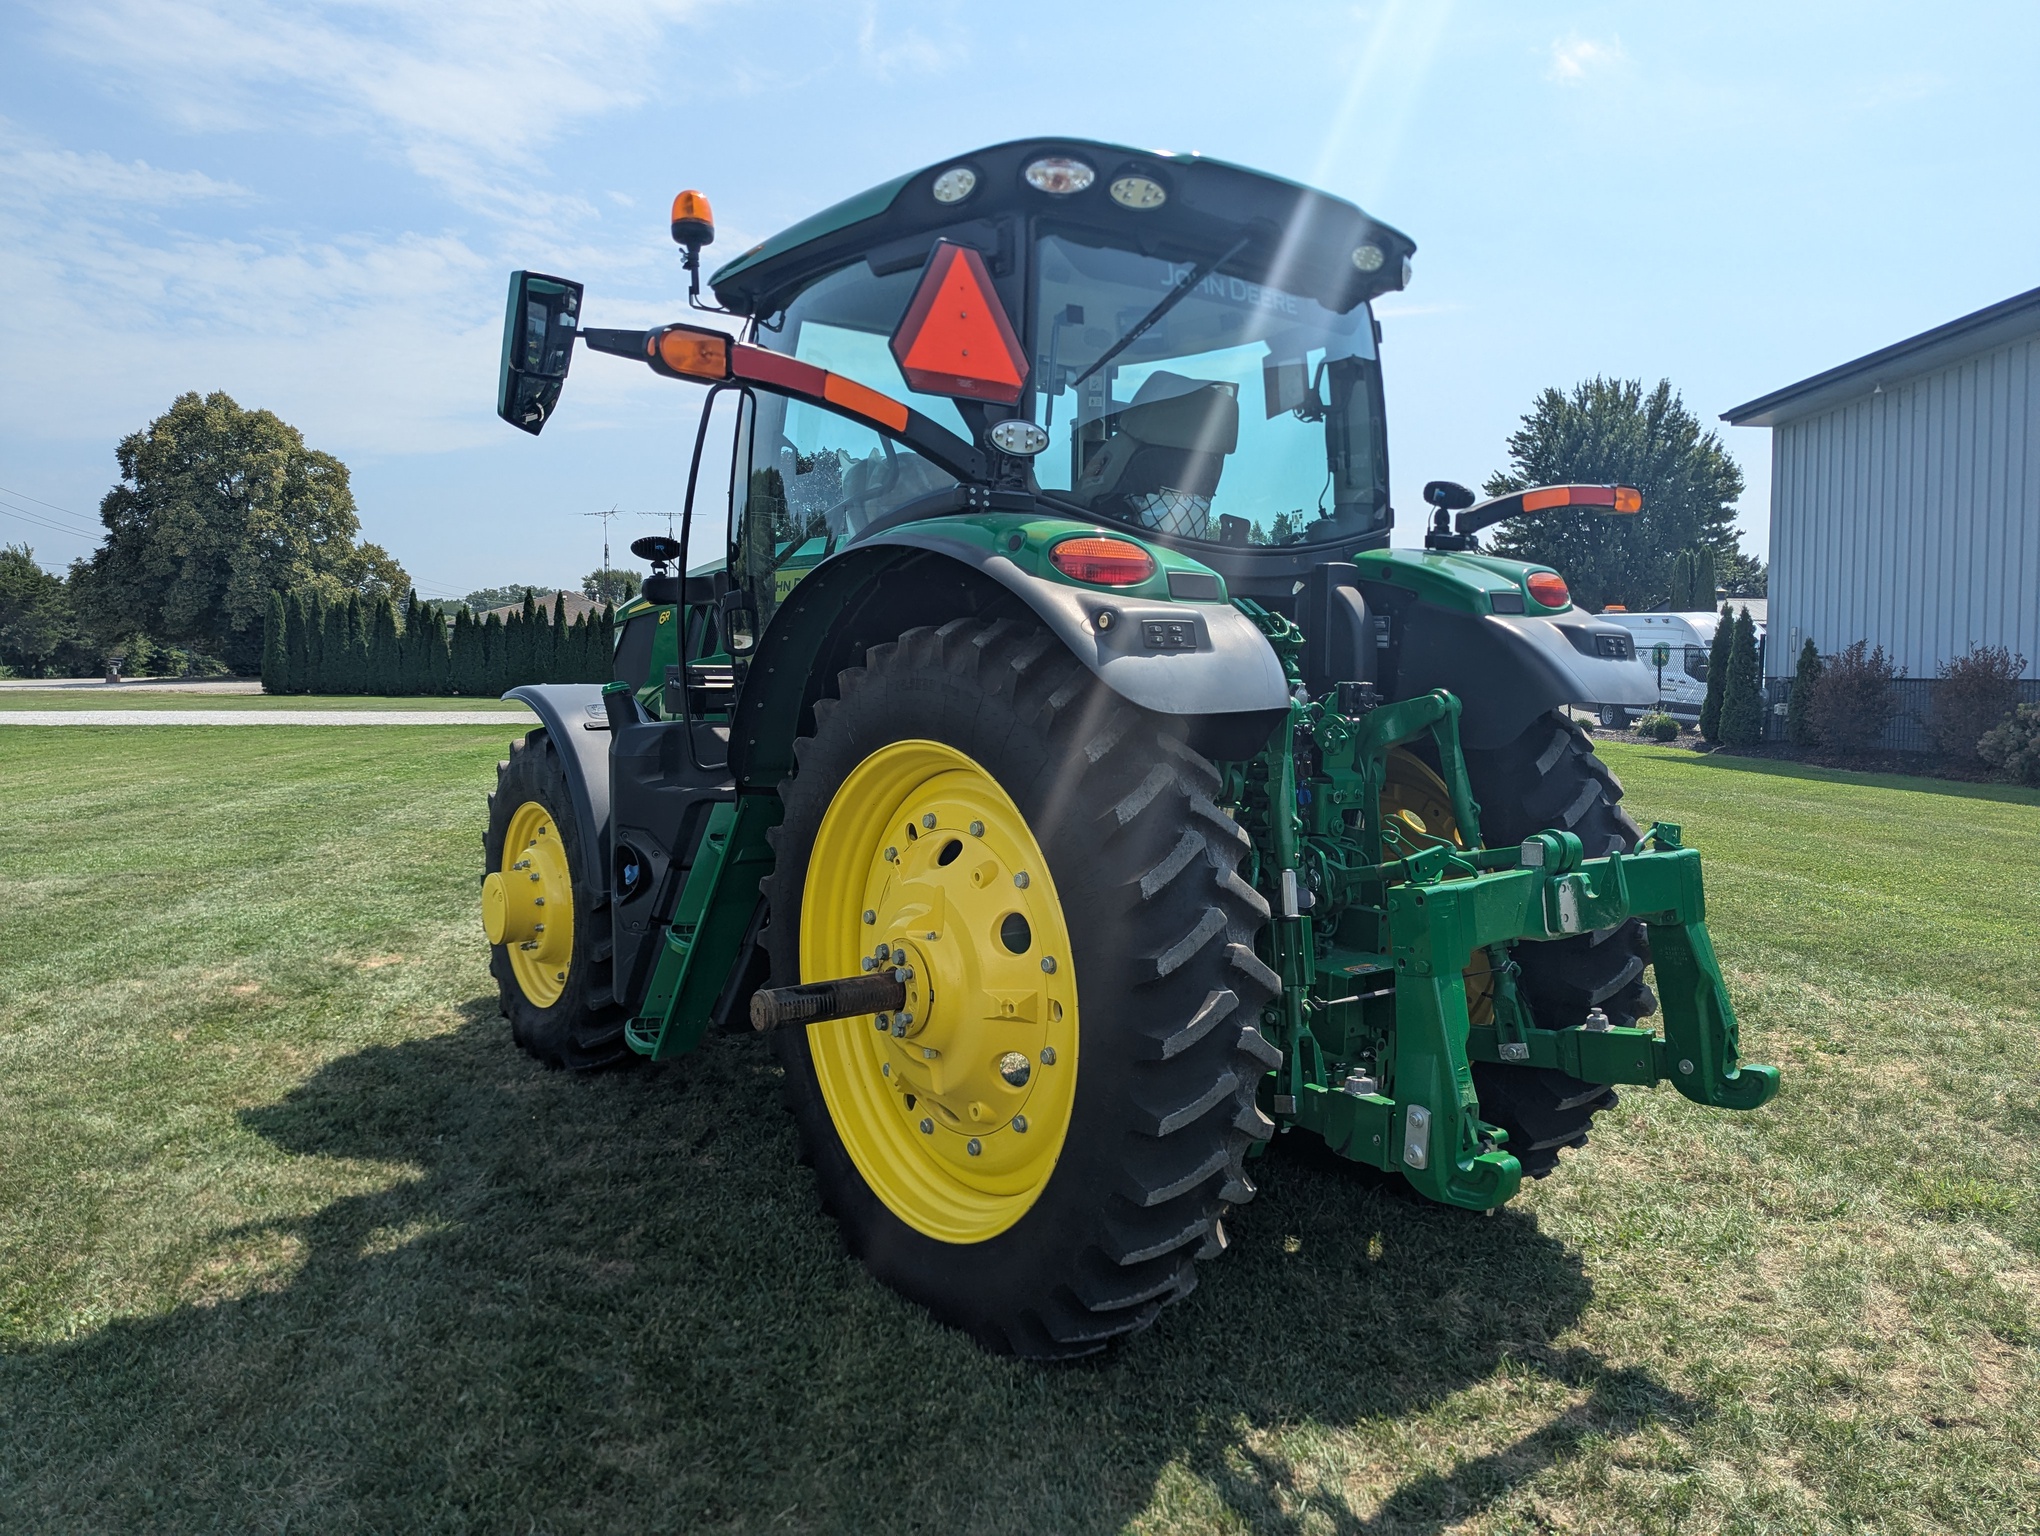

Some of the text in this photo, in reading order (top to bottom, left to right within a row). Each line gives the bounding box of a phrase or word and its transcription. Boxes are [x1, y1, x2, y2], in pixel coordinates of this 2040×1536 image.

[1230, 277, 1298, 315] DEERE
[775, 580, 791, 592] HN
[659, 610, 671, 625] 6R
